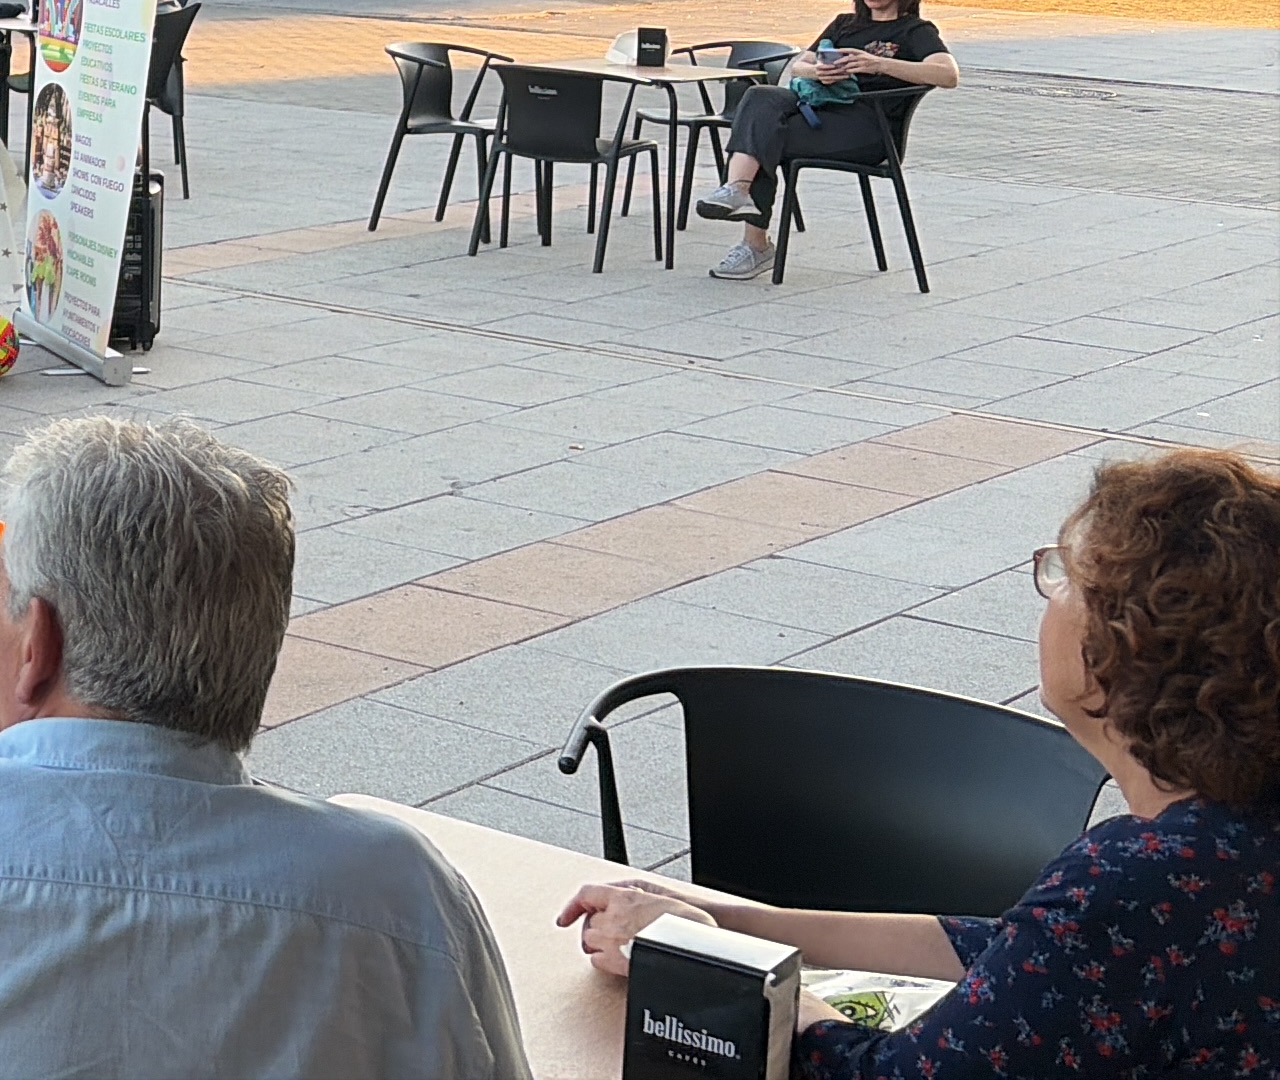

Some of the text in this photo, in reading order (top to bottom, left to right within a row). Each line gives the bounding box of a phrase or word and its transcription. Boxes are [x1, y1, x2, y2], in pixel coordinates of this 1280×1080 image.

[84, 22, 146, 43] FIESTAS ESCOLARES
[82, 39, 113, 55] PROYECTOS
[80, 56, 113, 73] EDUCATIVOS
[80, 73, 137, 96] FIESTAS DE VERANO
[78, 90, 116, 108] EVENTOS PARA
[76, 106, 103, 124] EMPRESAS
[75, 133, 92, 148] MAGOS
[80, 152, 106, 169] ANIMADOR
[90, 173, 102, 187] CON
[102, 176, 125, 193] FUEGO
